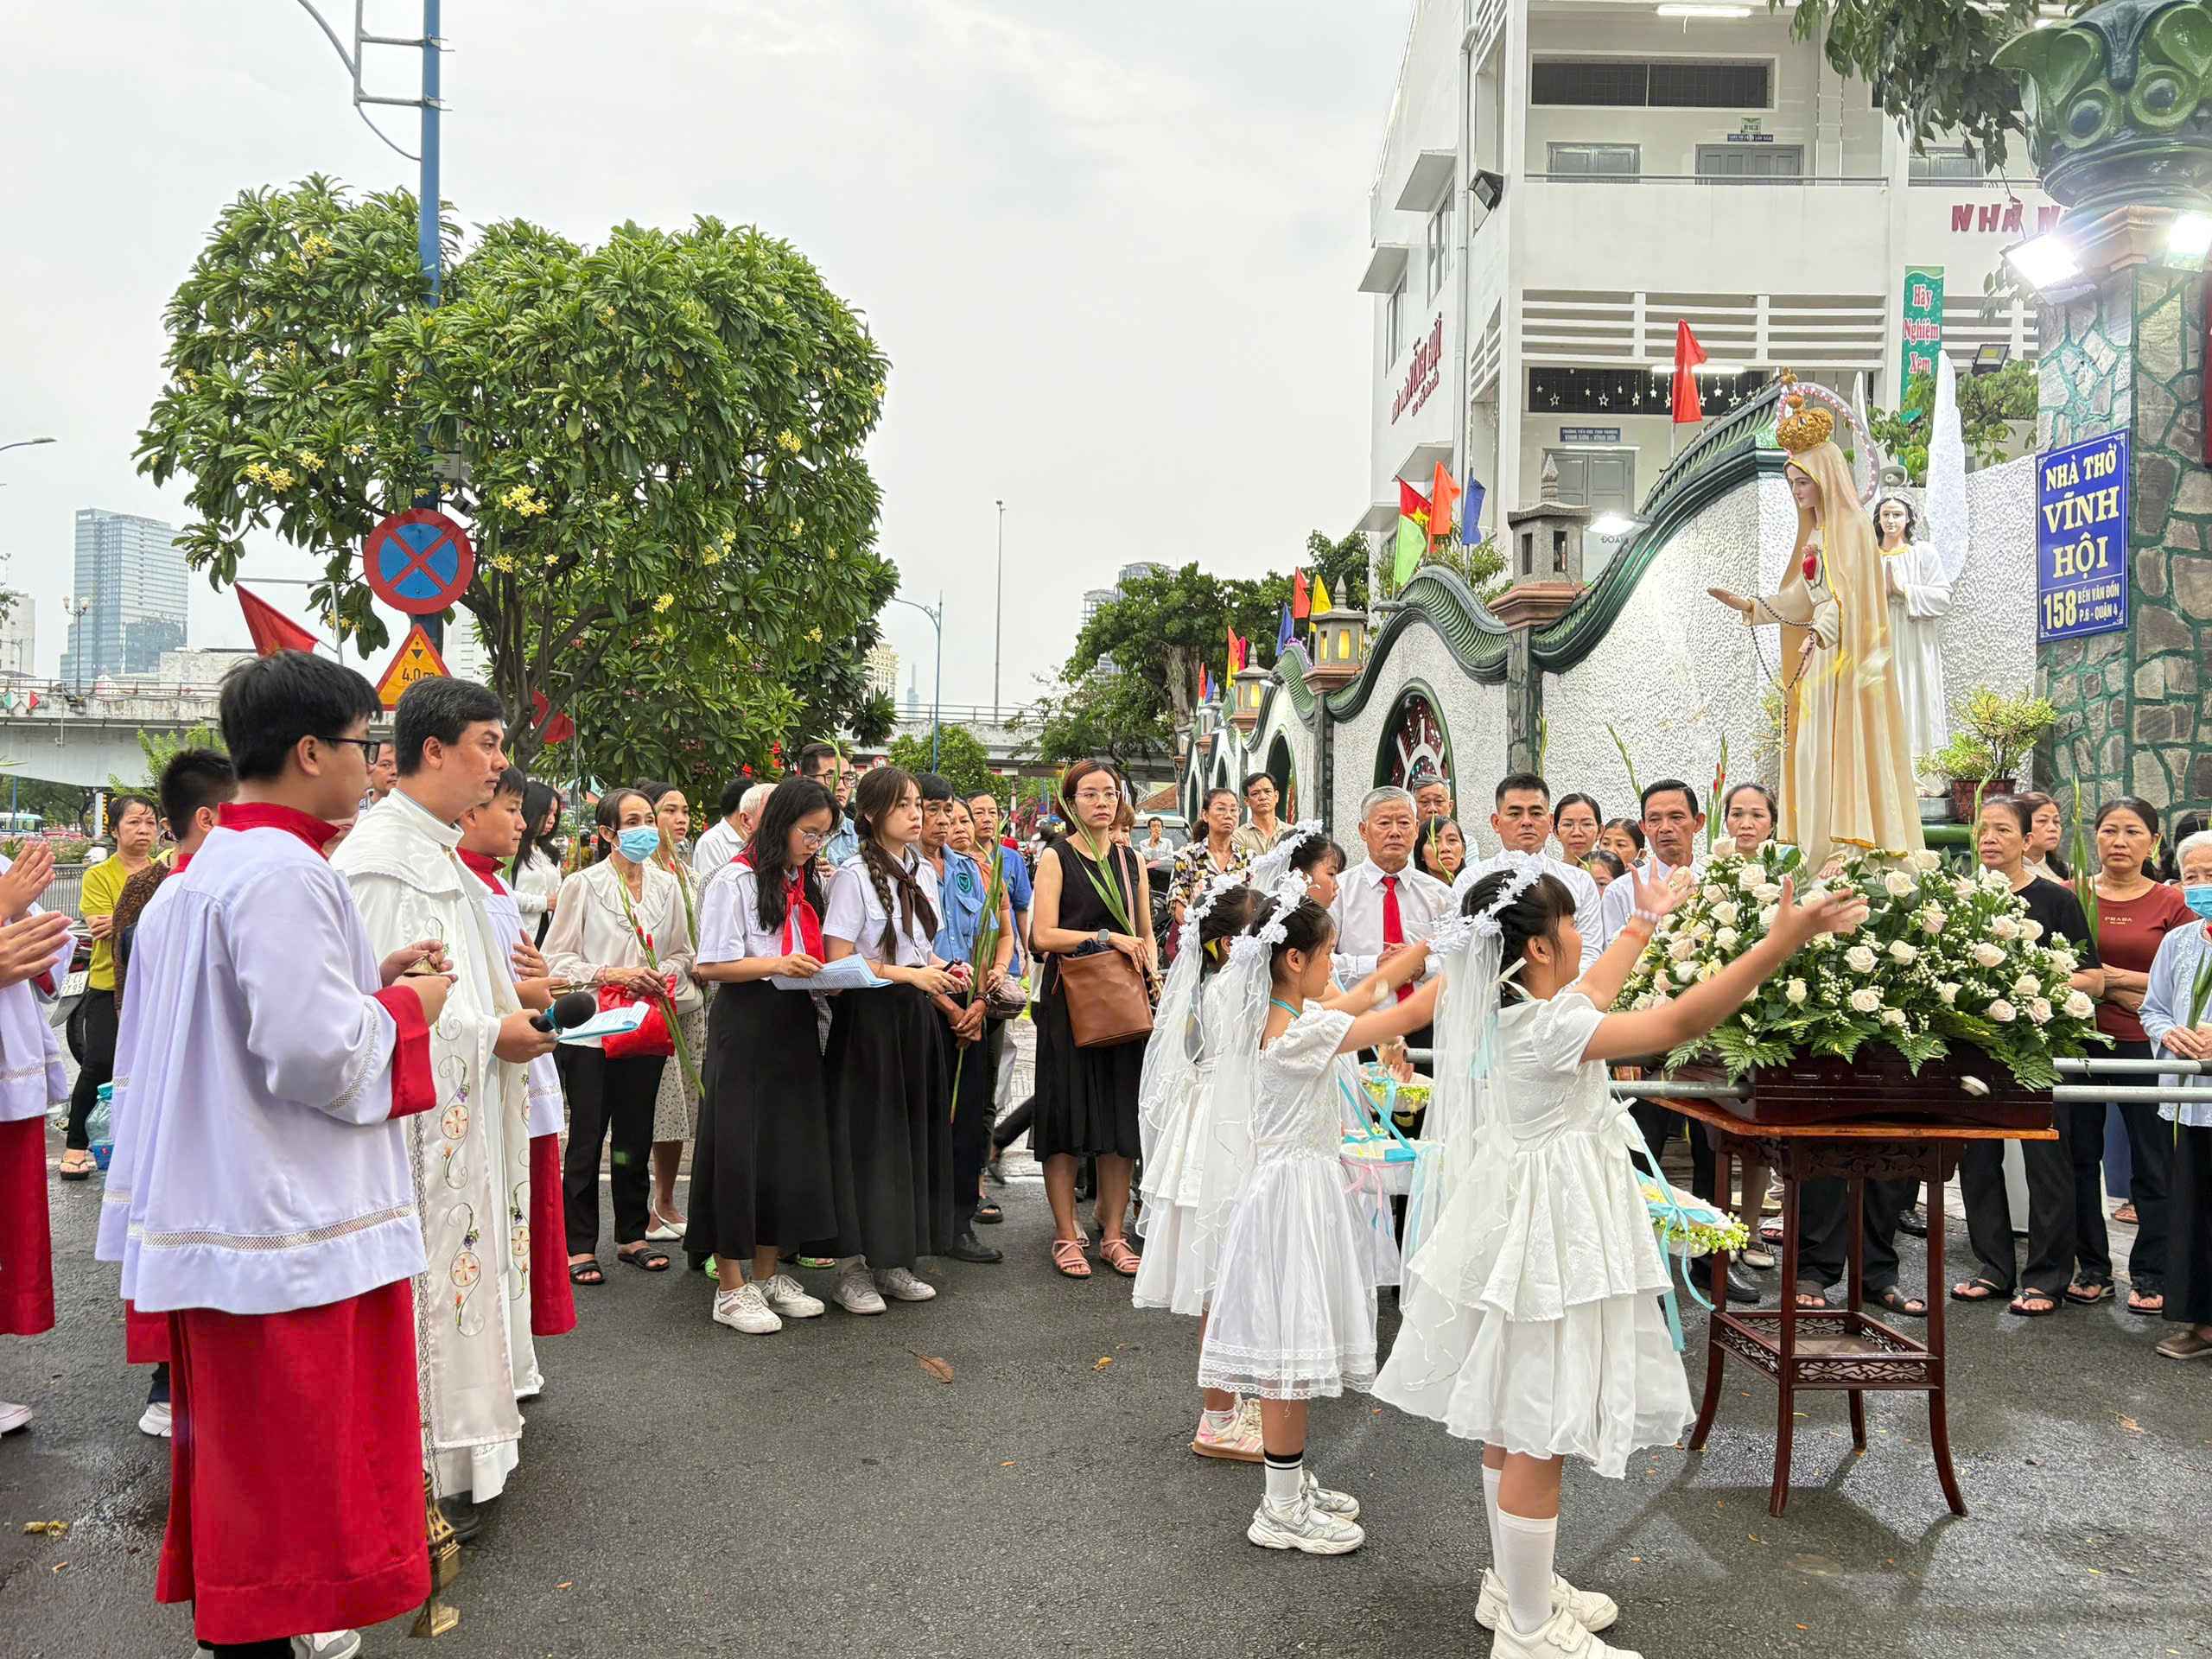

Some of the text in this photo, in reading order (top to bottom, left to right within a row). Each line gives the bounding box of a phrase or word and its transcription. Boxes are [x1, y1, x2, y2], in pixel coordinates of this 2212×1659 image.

[2045, 442, 2117, 492] NHÀ THỜ
[2043, 485, 2120, 533] VĨNH
[2053, 531, 2108, 580] HỘI
[2044, 589, 2077, 630] 158
